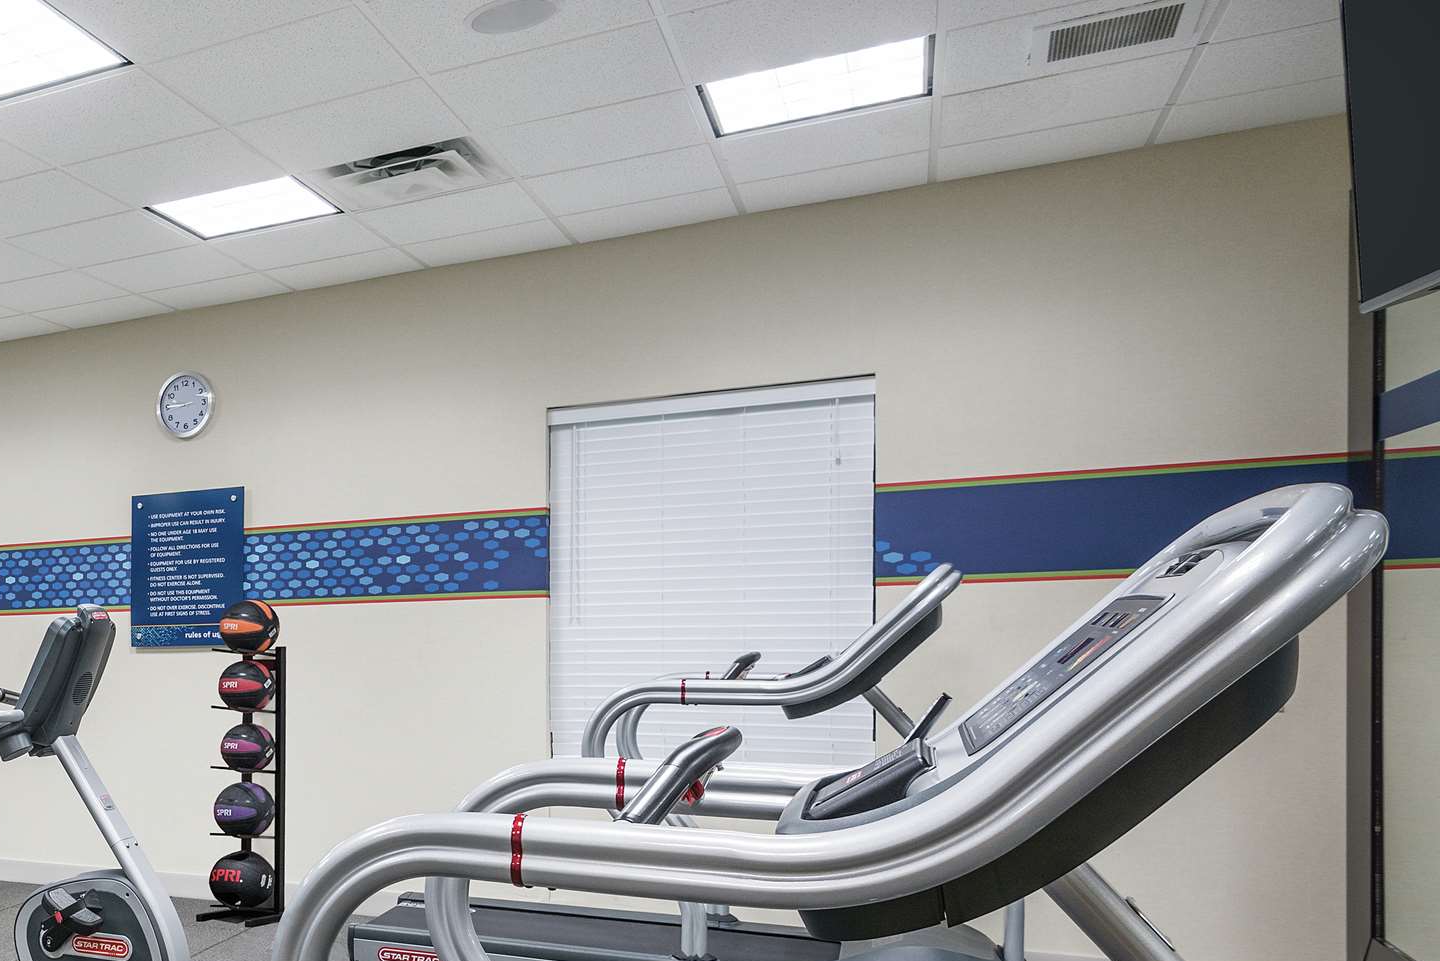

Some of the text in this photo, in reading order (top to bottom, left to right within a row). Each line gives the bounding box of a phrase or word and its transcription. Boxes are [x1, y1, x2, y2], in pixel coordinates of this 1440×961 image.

[222, 680, 238, 689] SPRI
[224, 742, 238, 750] SPRI
[76, 940, 124, 952] STAR TRAC
[382, 952, 410, 961] STAR
